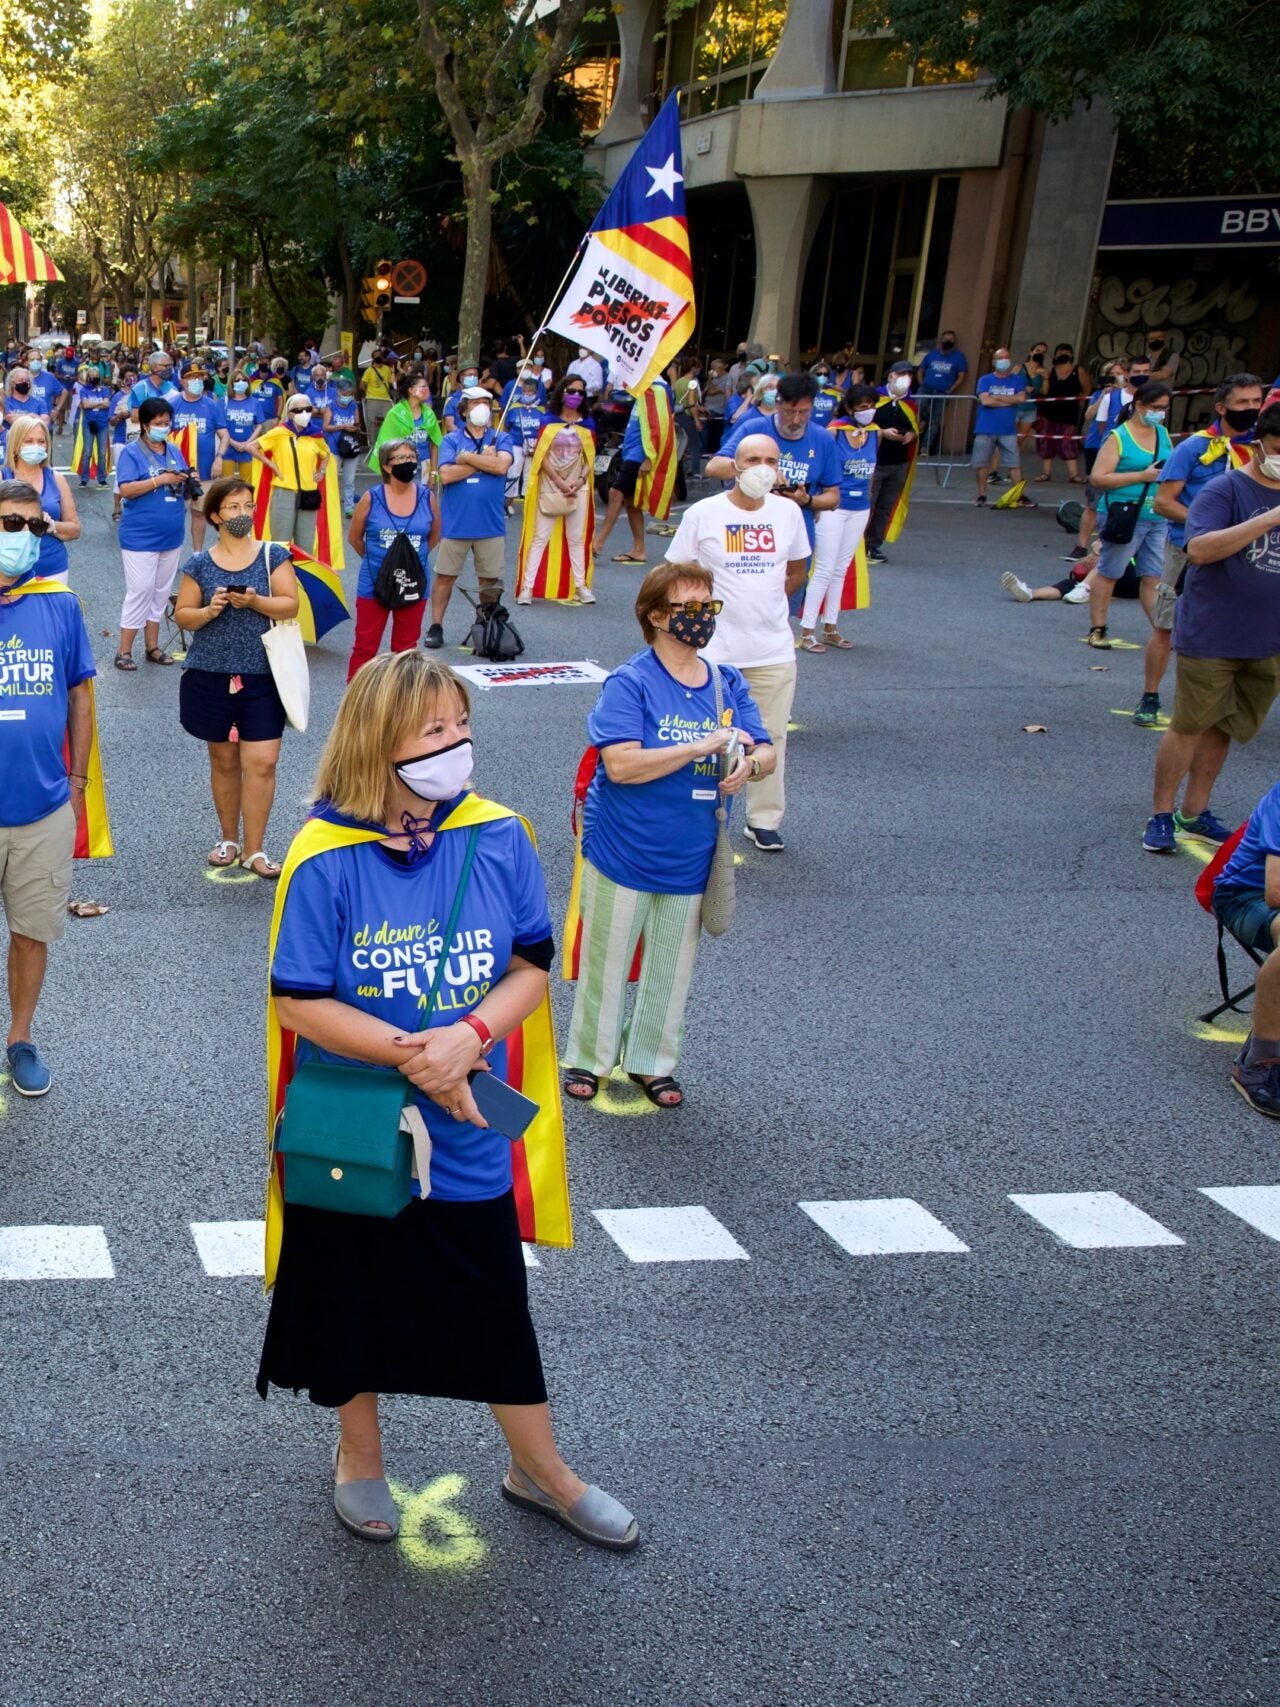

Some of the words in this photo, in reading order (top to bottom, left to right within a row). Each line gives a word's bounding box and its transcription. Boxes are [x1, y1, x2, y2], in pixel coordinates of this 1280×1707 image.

[744, 530, 774, 550] SC
[7, 634, 24, 650] de
[702, 717, 718, 731] de
[354, 924, 371, 947] el
[374, 920, 426, 945] deure
[358, 985, 382, 997] un
